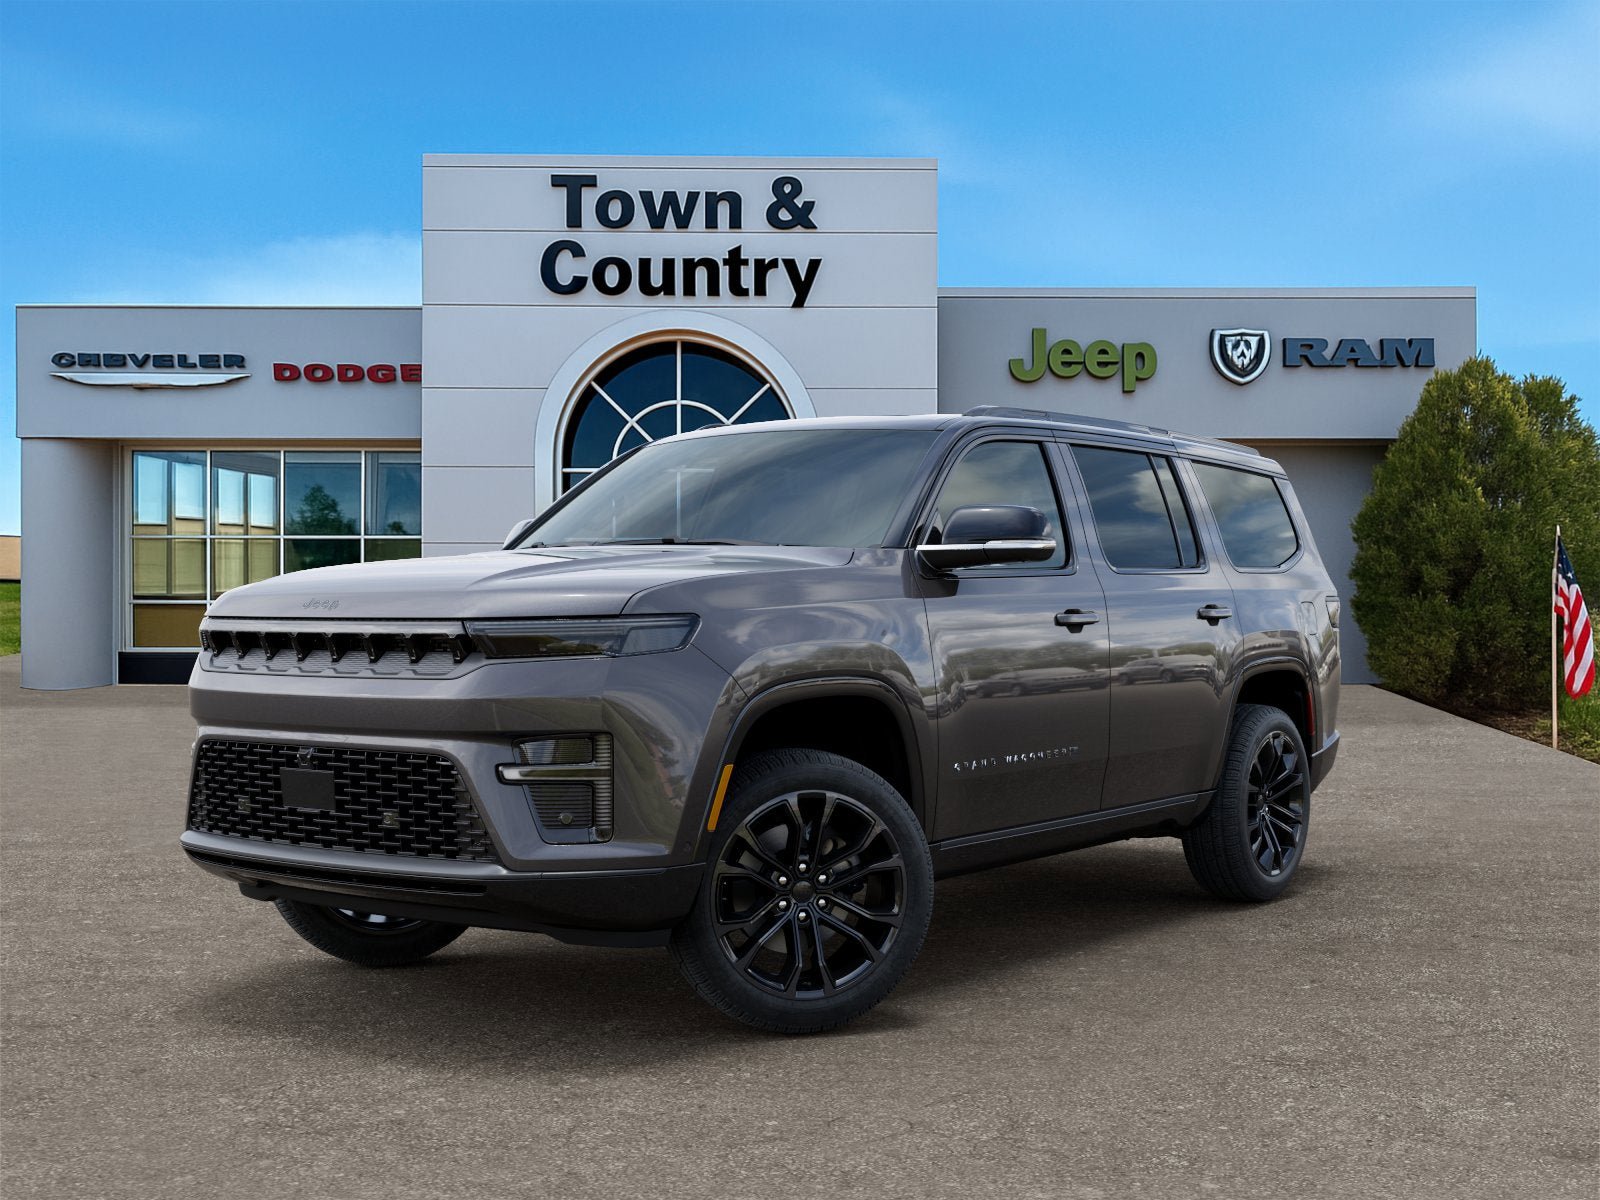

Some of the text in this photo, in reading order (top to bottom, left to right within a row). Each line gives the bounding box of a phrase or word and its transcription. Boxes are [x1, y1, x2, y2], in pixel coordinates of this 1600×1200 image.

[550, 174, 818, 230] Town &
[540, 239, 822, 308] Country
[273, 362, 422, 383] DODGE
[1008, 327, 1157, 393] Jeep
[1282, 337, 1435, 368] RAM
[302, 597, 340, 611] Jeep
